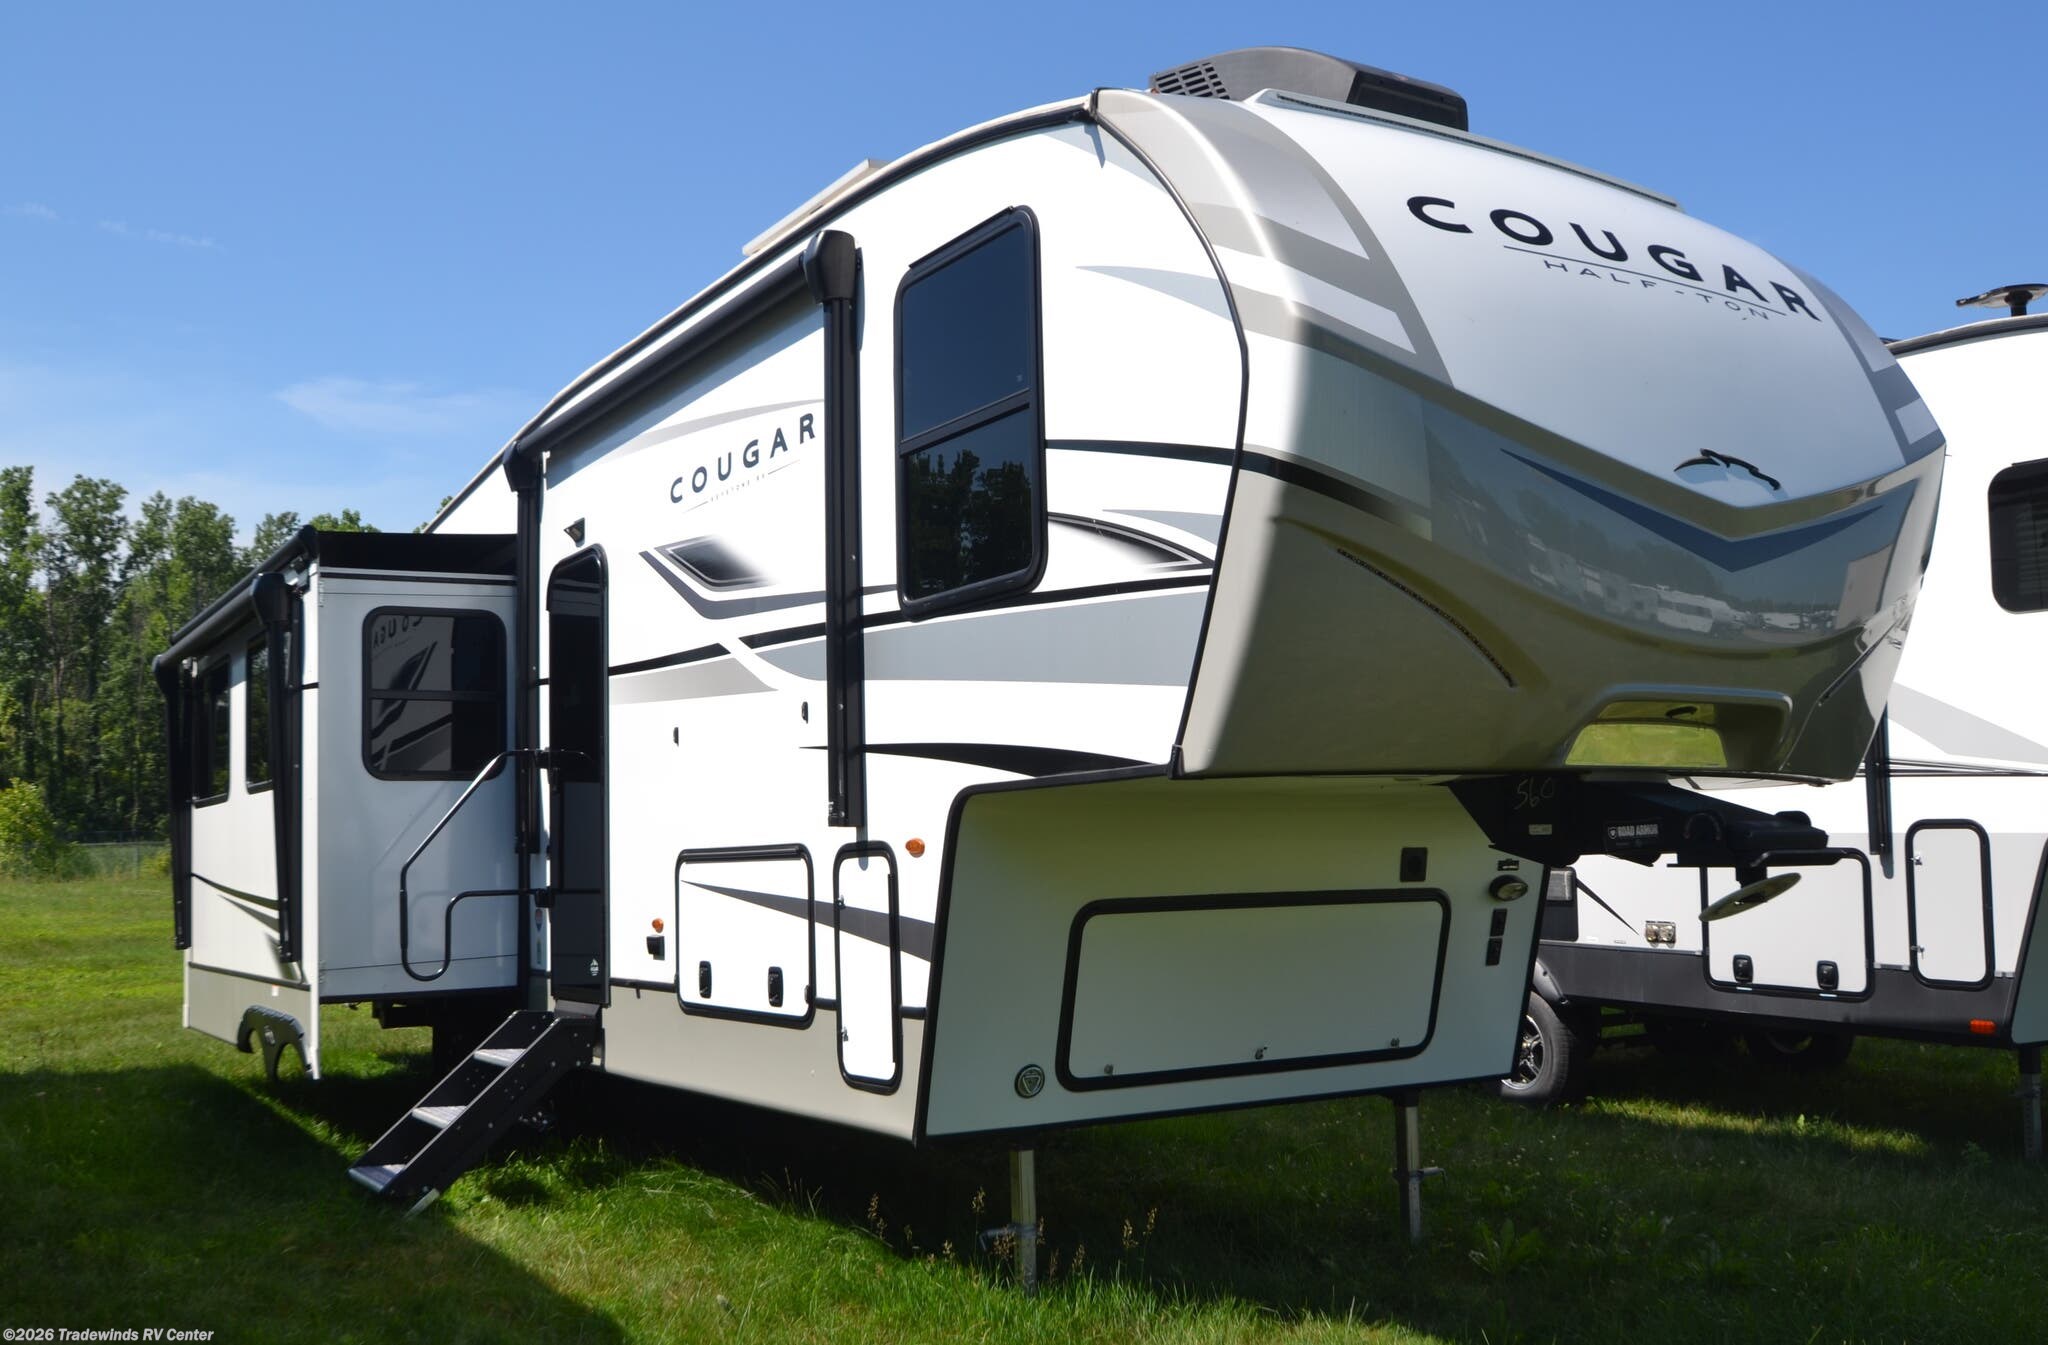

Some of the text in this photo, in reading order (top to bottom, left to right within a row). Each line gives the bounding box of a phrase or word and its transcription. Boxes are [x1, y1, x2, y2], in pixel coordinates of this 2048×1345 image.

[1407, 196, 1822, 322] COUGAR
[1544, 260, 1769, 321] HALF-TON
[670, 413, 815, 504] COUGAR
